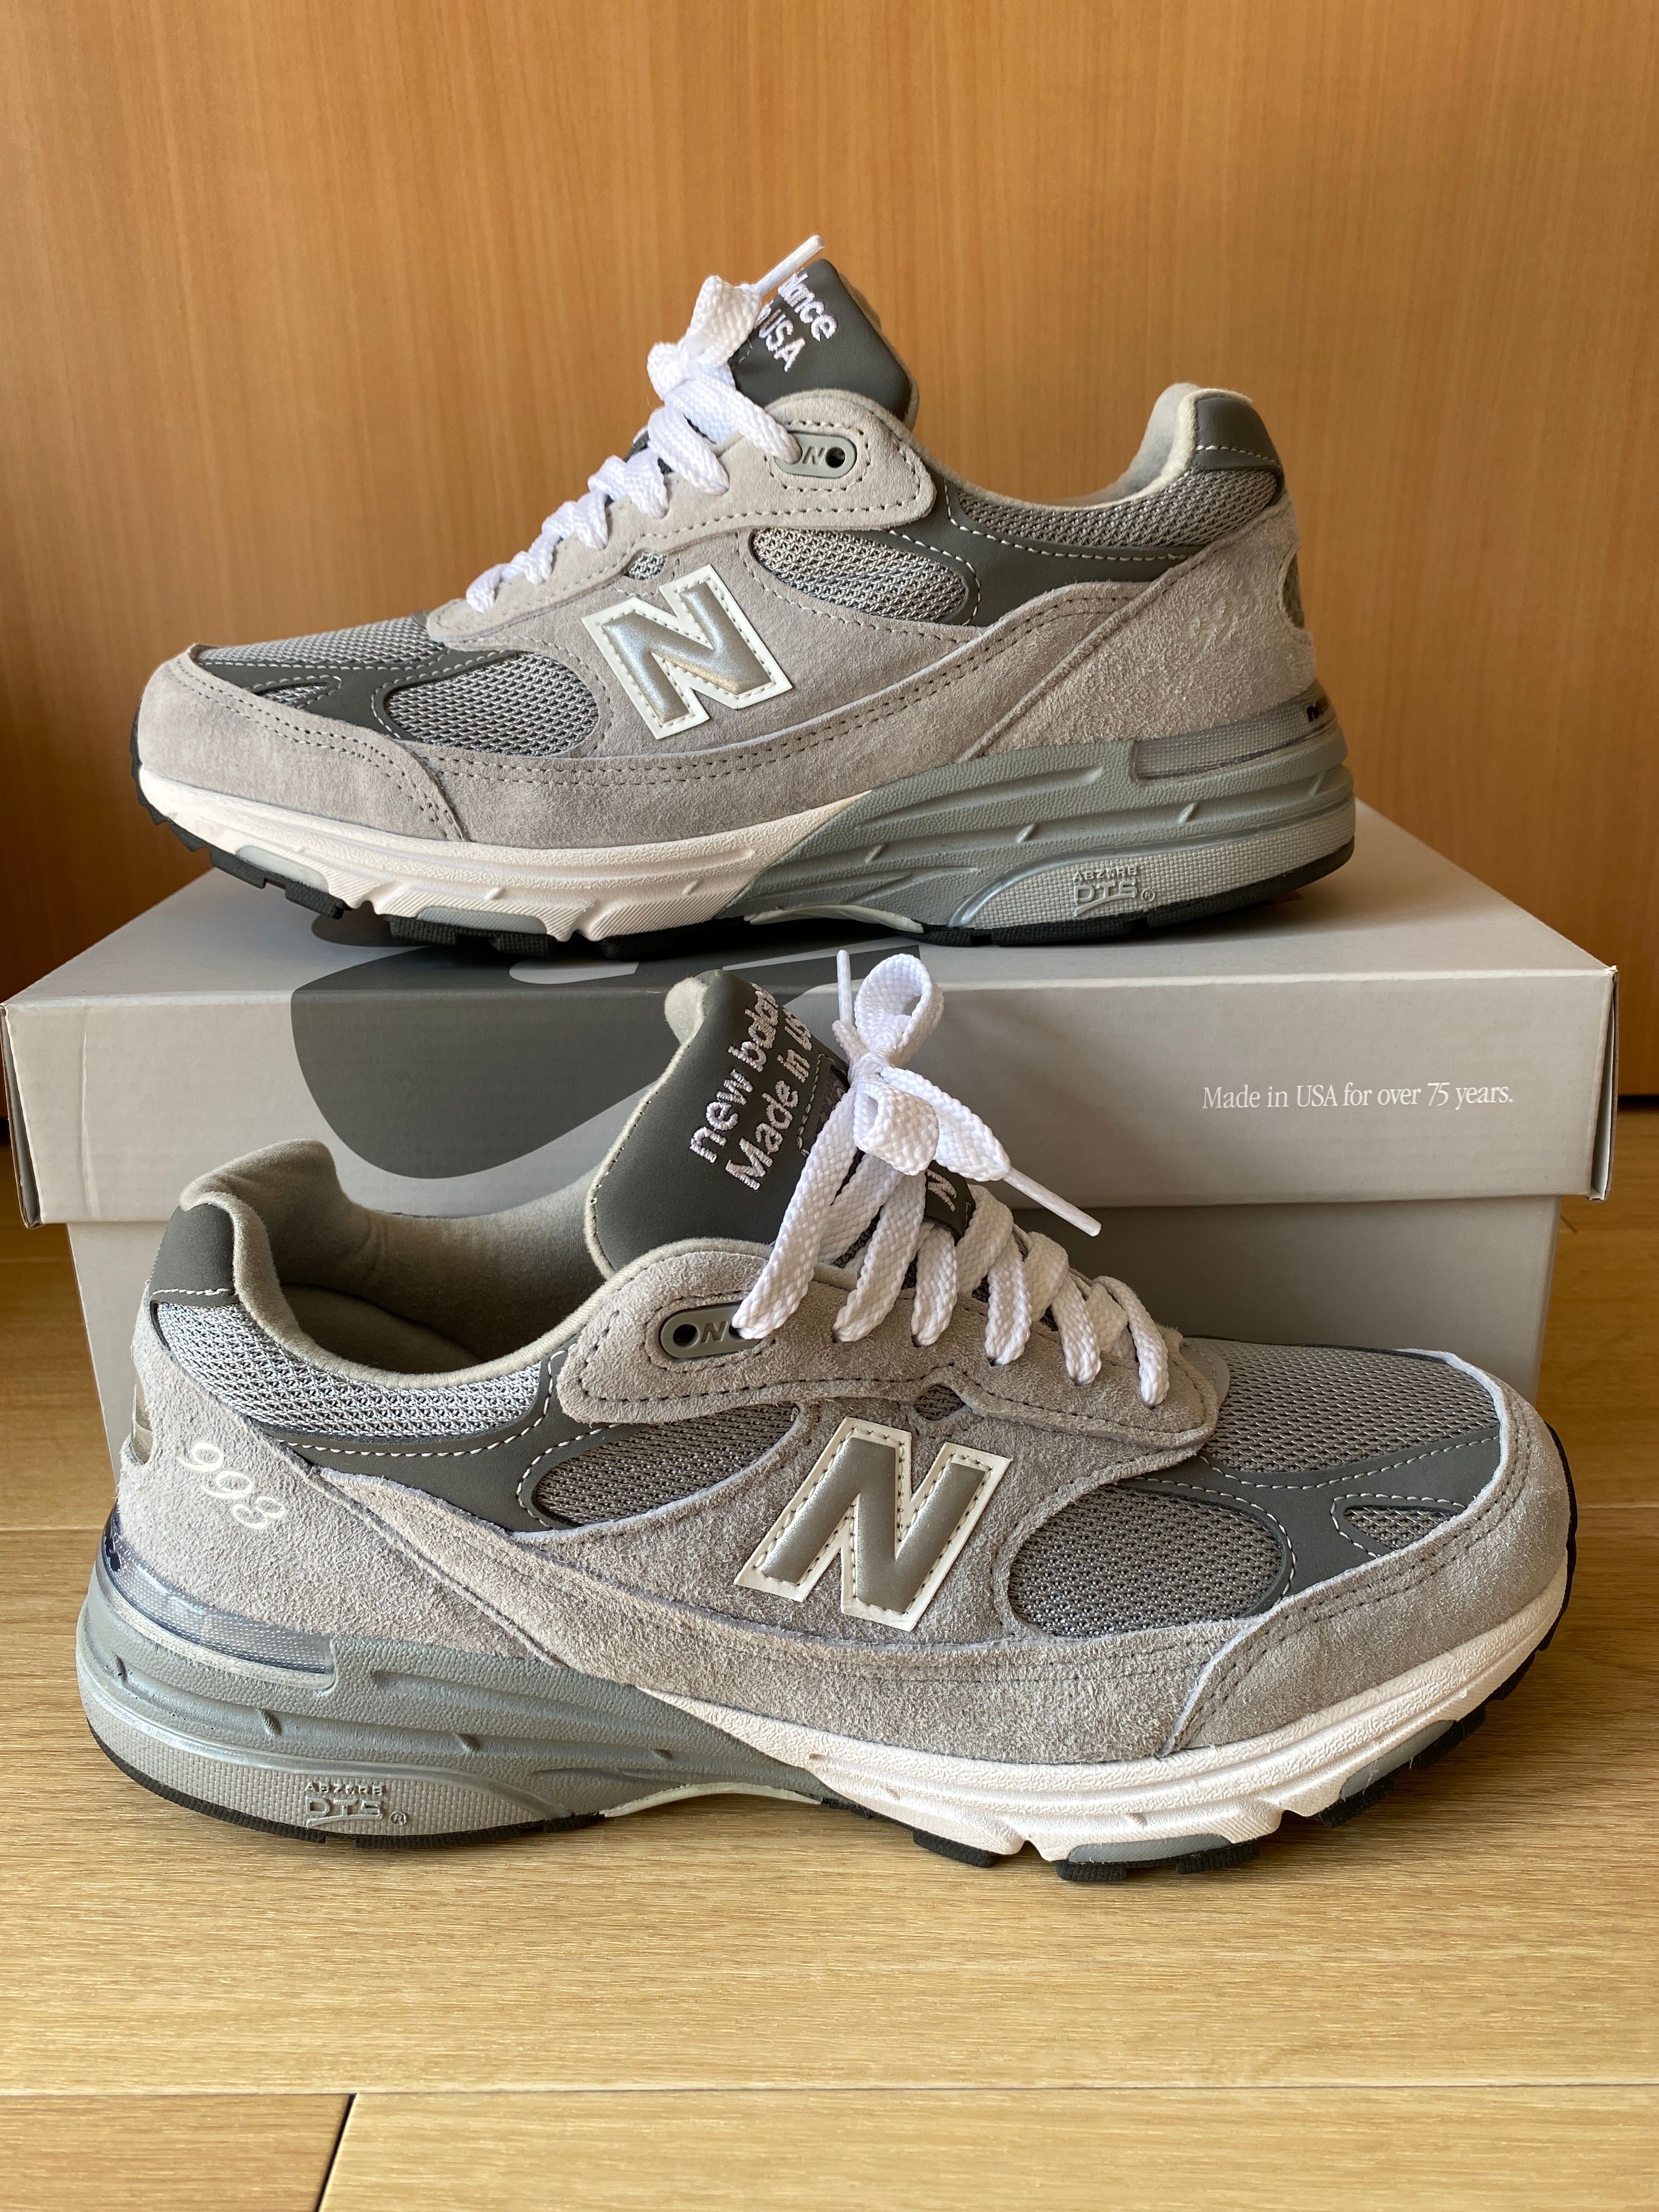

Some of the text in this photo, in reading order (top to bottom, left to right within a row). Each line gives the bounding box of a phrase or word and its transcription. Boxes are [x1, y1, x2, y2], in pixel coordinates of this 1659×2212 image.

[759, 308, 805, 373] USA
[581, 563, 793, 740] N
[1074, 879, 1138, 904] DTS
[689, 1068, 753, 1164] new
[725, 1080, 799, 1190] Made
[777, 1049, 810, 1083] in
[1202, 1082, 1514, 1110] Made in USA for over 75 years.
[177, 1441, 286, 1530] 993
[733, 1416, 1012, 1632] N
[305, 1795, 383, 1820] DTS
